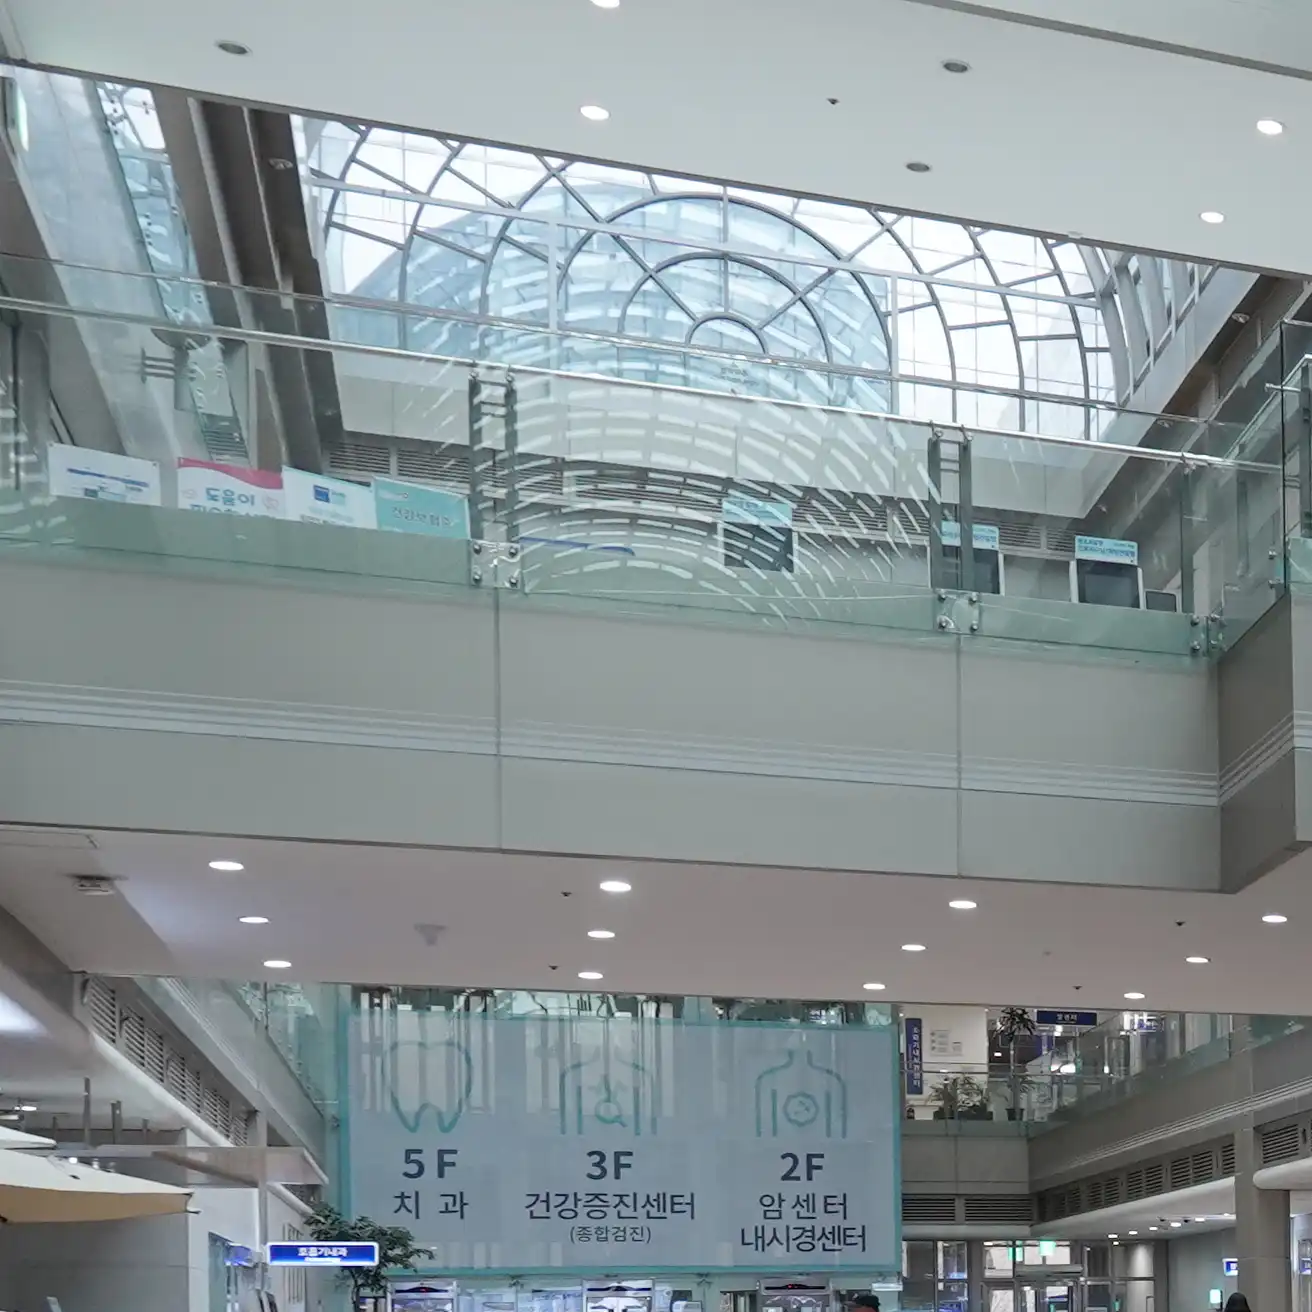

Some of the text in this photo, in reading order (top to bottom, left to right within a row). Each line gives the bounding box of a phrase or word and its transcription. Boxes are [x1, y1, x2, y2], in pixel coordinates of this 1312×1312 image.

[205, 486, 256, 507] 도움이
[402, 1148, 459, 1180] 5F
[586, 1150, 634, 1181] 3F
[780, 1152, 825, 1182] 2F
[525, 1191, 695, 1221] 건강증진센터
[759, 1192, 848, 1221] 암센터
[569, 1225, 652, 1245] (종합검진)
[740, 1224, 867, 1253] 내시경센터
